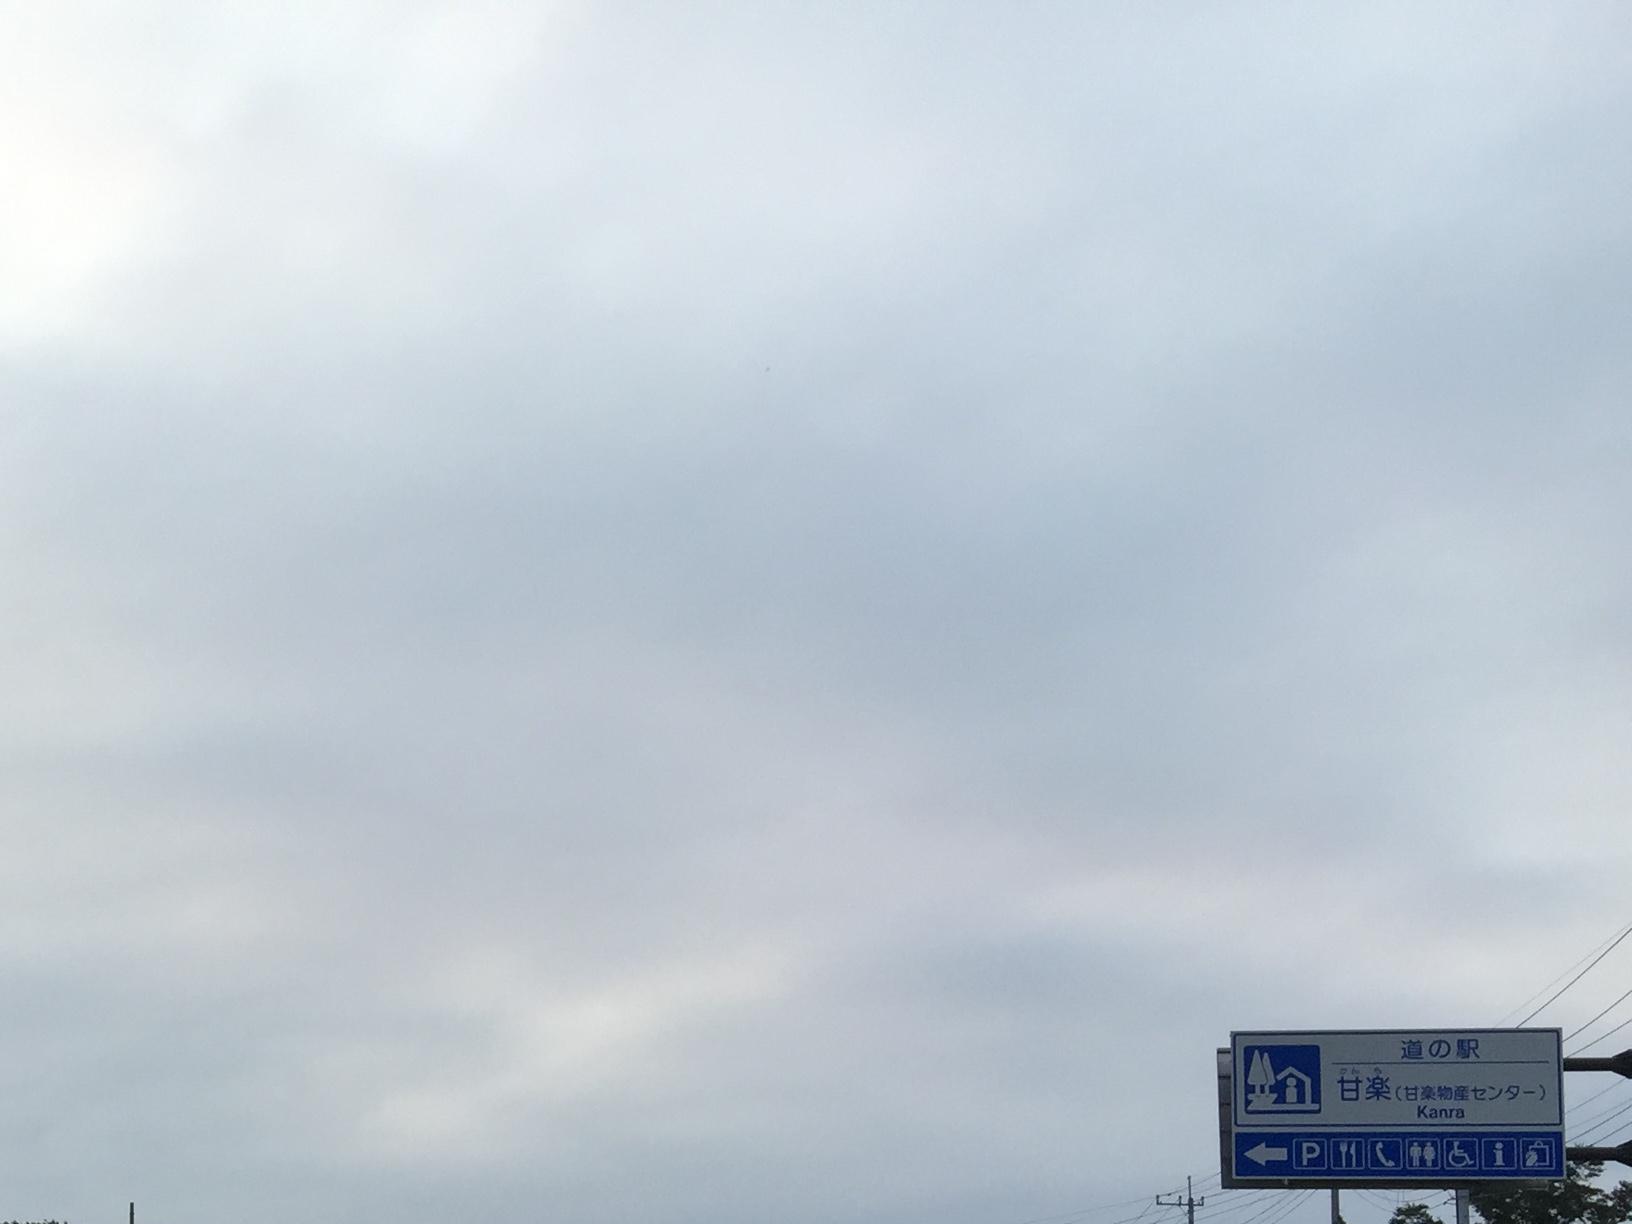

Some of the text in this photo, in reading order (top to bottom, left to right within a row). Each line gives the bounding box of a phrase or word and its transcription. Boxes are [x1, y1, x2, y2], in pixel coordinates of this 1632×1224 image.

[1401, 1039, 1480, 1060] 道の駅
[1336, 1075, 1392, 1101] 甘楽
[1417, 1105, 1465, 1119] Kanra
[1302, 1142, 1321, 1166] P
